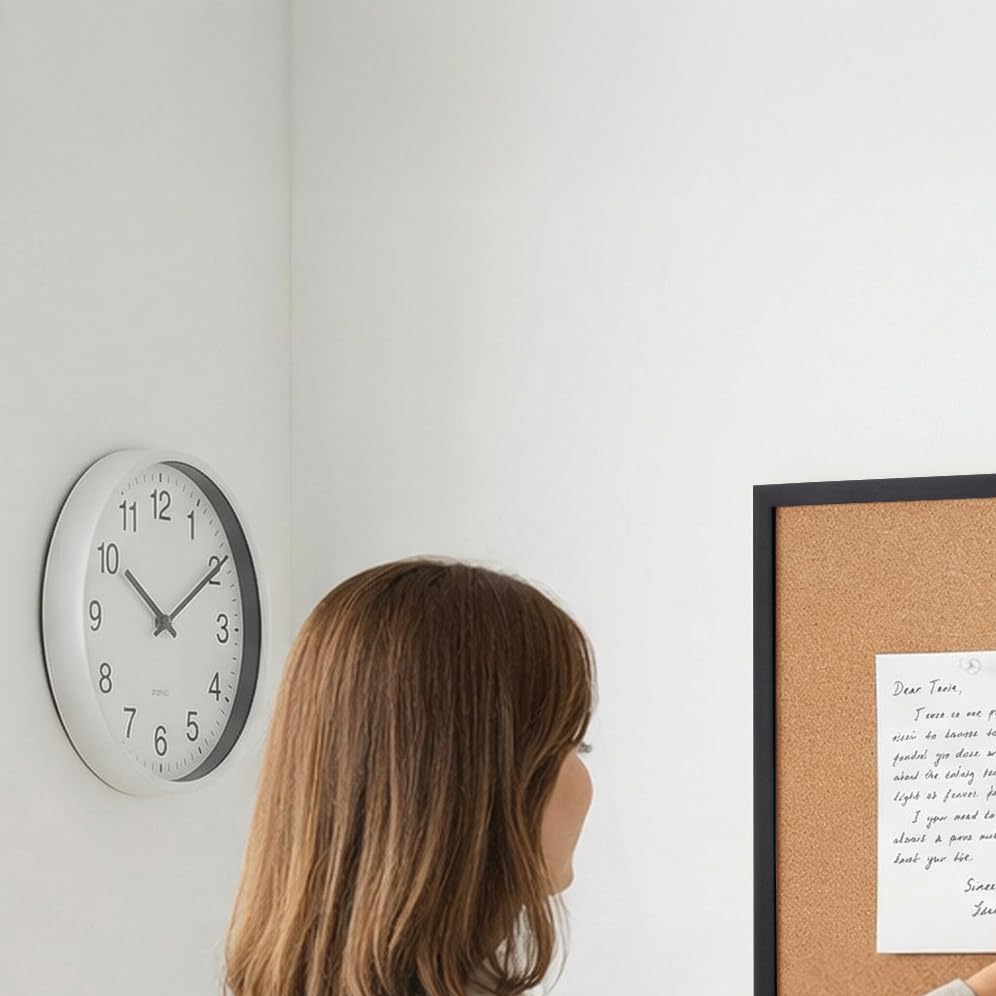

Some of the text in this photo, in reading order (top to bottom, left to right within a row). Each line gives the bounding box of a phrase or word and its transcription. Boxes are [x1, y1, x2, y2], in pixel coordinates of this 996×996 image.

[119, 499, 137, 532] 11
[150, 489, 171, 521] 12
[187, 510, 195, 540] 1
[97, 541, 119, 575] 10
[208, 555, 222, 586] 2
[89, 599, 101, 632] 9
[216, 613, 229, 643] 3
[99, 662, 112, 693] 8
[208, 672, 221, 701] 4
[892, 681, 921, 696] Dear
[123, 707, 137, 738] 7
[186, 710, 199, 742] 5
[154, 725, 167, 756] 6
